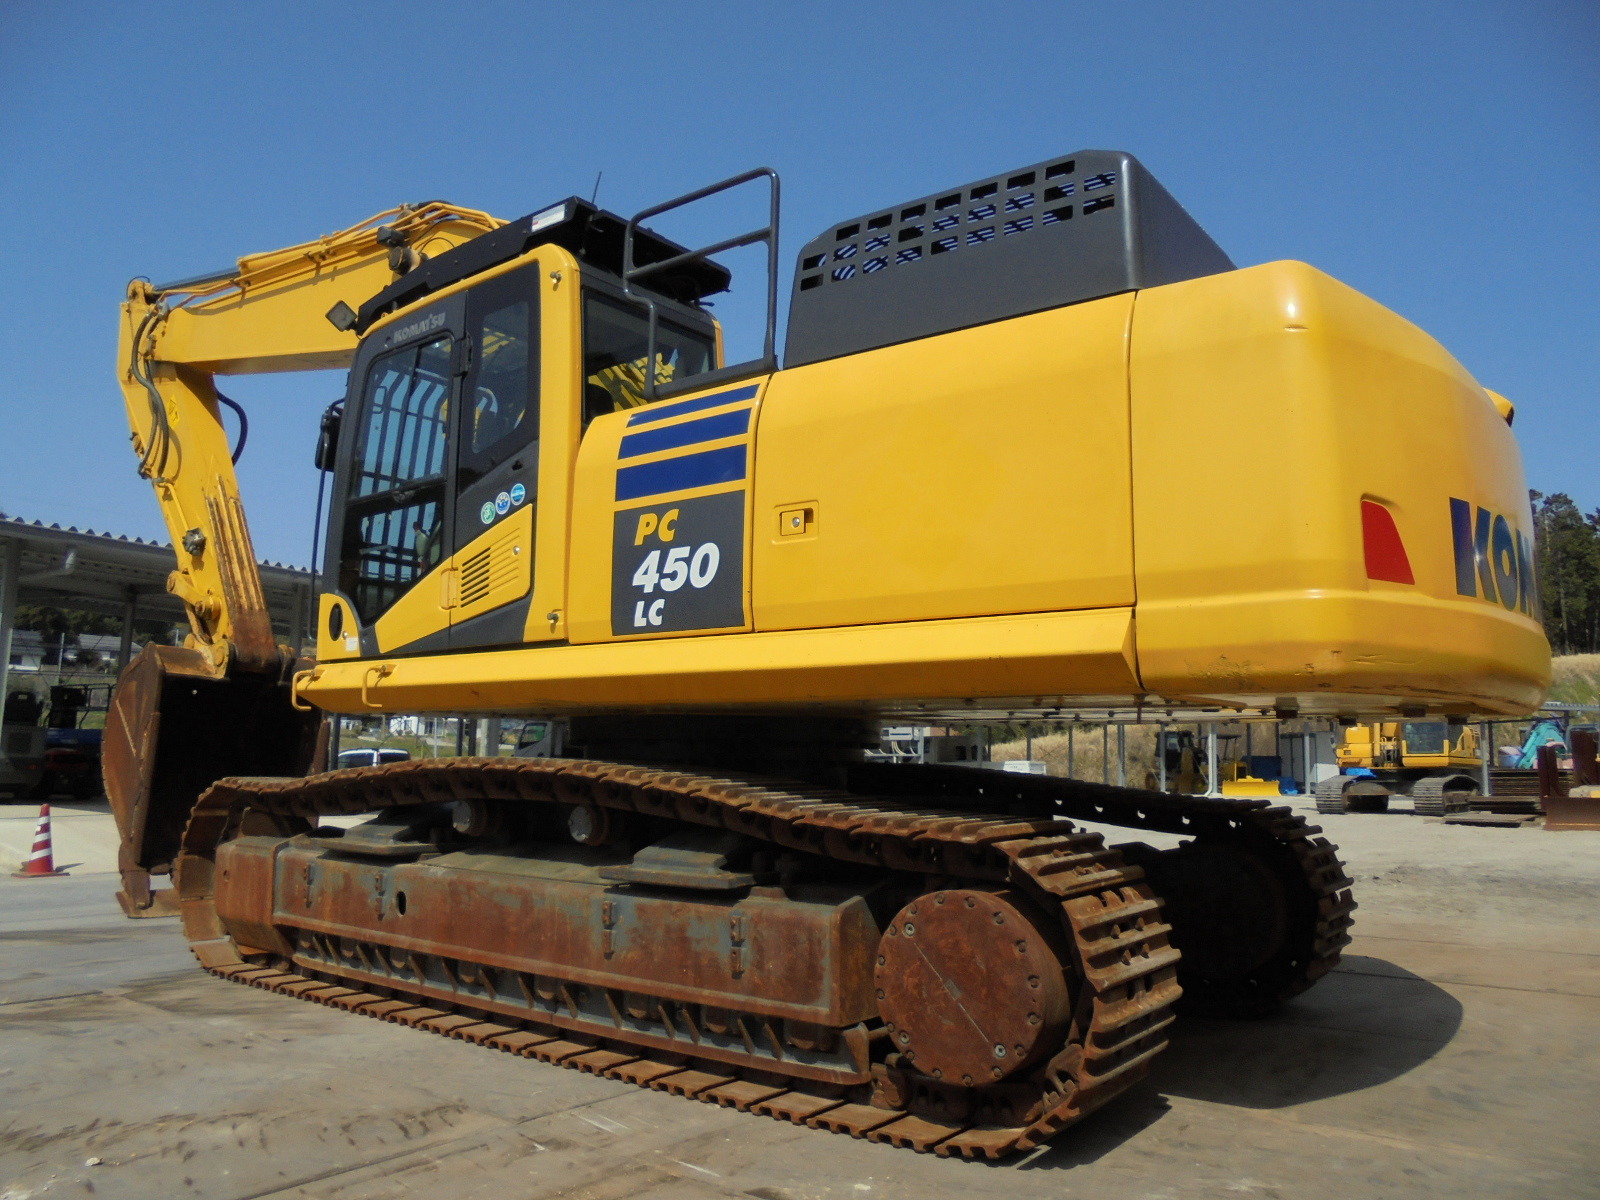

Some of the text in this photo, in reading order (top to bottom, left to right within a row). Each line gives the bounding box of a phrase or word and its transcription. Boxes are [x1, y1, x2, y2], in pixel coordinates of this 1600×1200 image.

[393, 312, 446, 343] KOMATSU
[634, 508, 679, 545] PC
[632, 542, 720, 593] 450
[633, 599, 665, 627] LC
